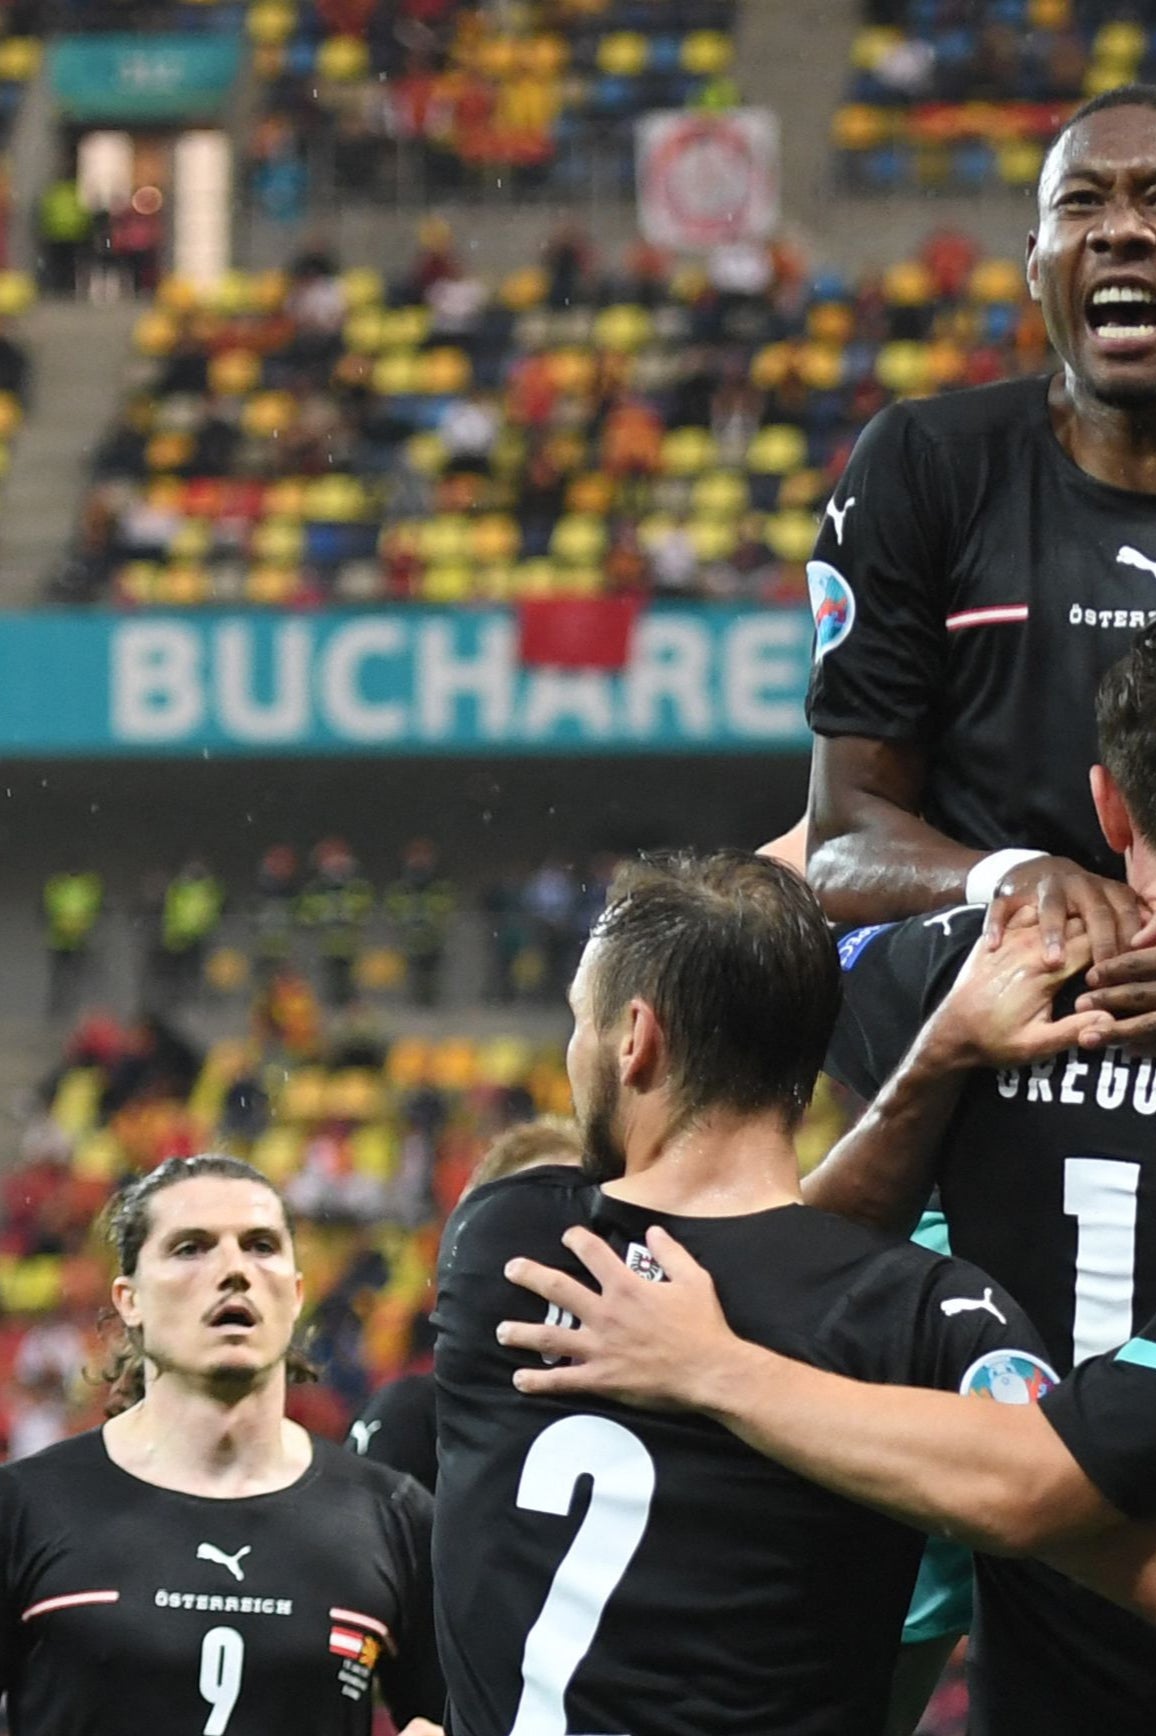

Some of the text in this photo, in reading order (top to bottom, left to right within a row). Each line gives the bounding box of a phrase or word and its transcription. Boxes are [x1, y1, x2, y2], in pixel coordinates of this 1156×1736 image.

[154, 1589, 293, 1616] ÖSTERREICH
[508, 1414, 656, 1736] 2
[199, 1626, 244, 1736] 9
